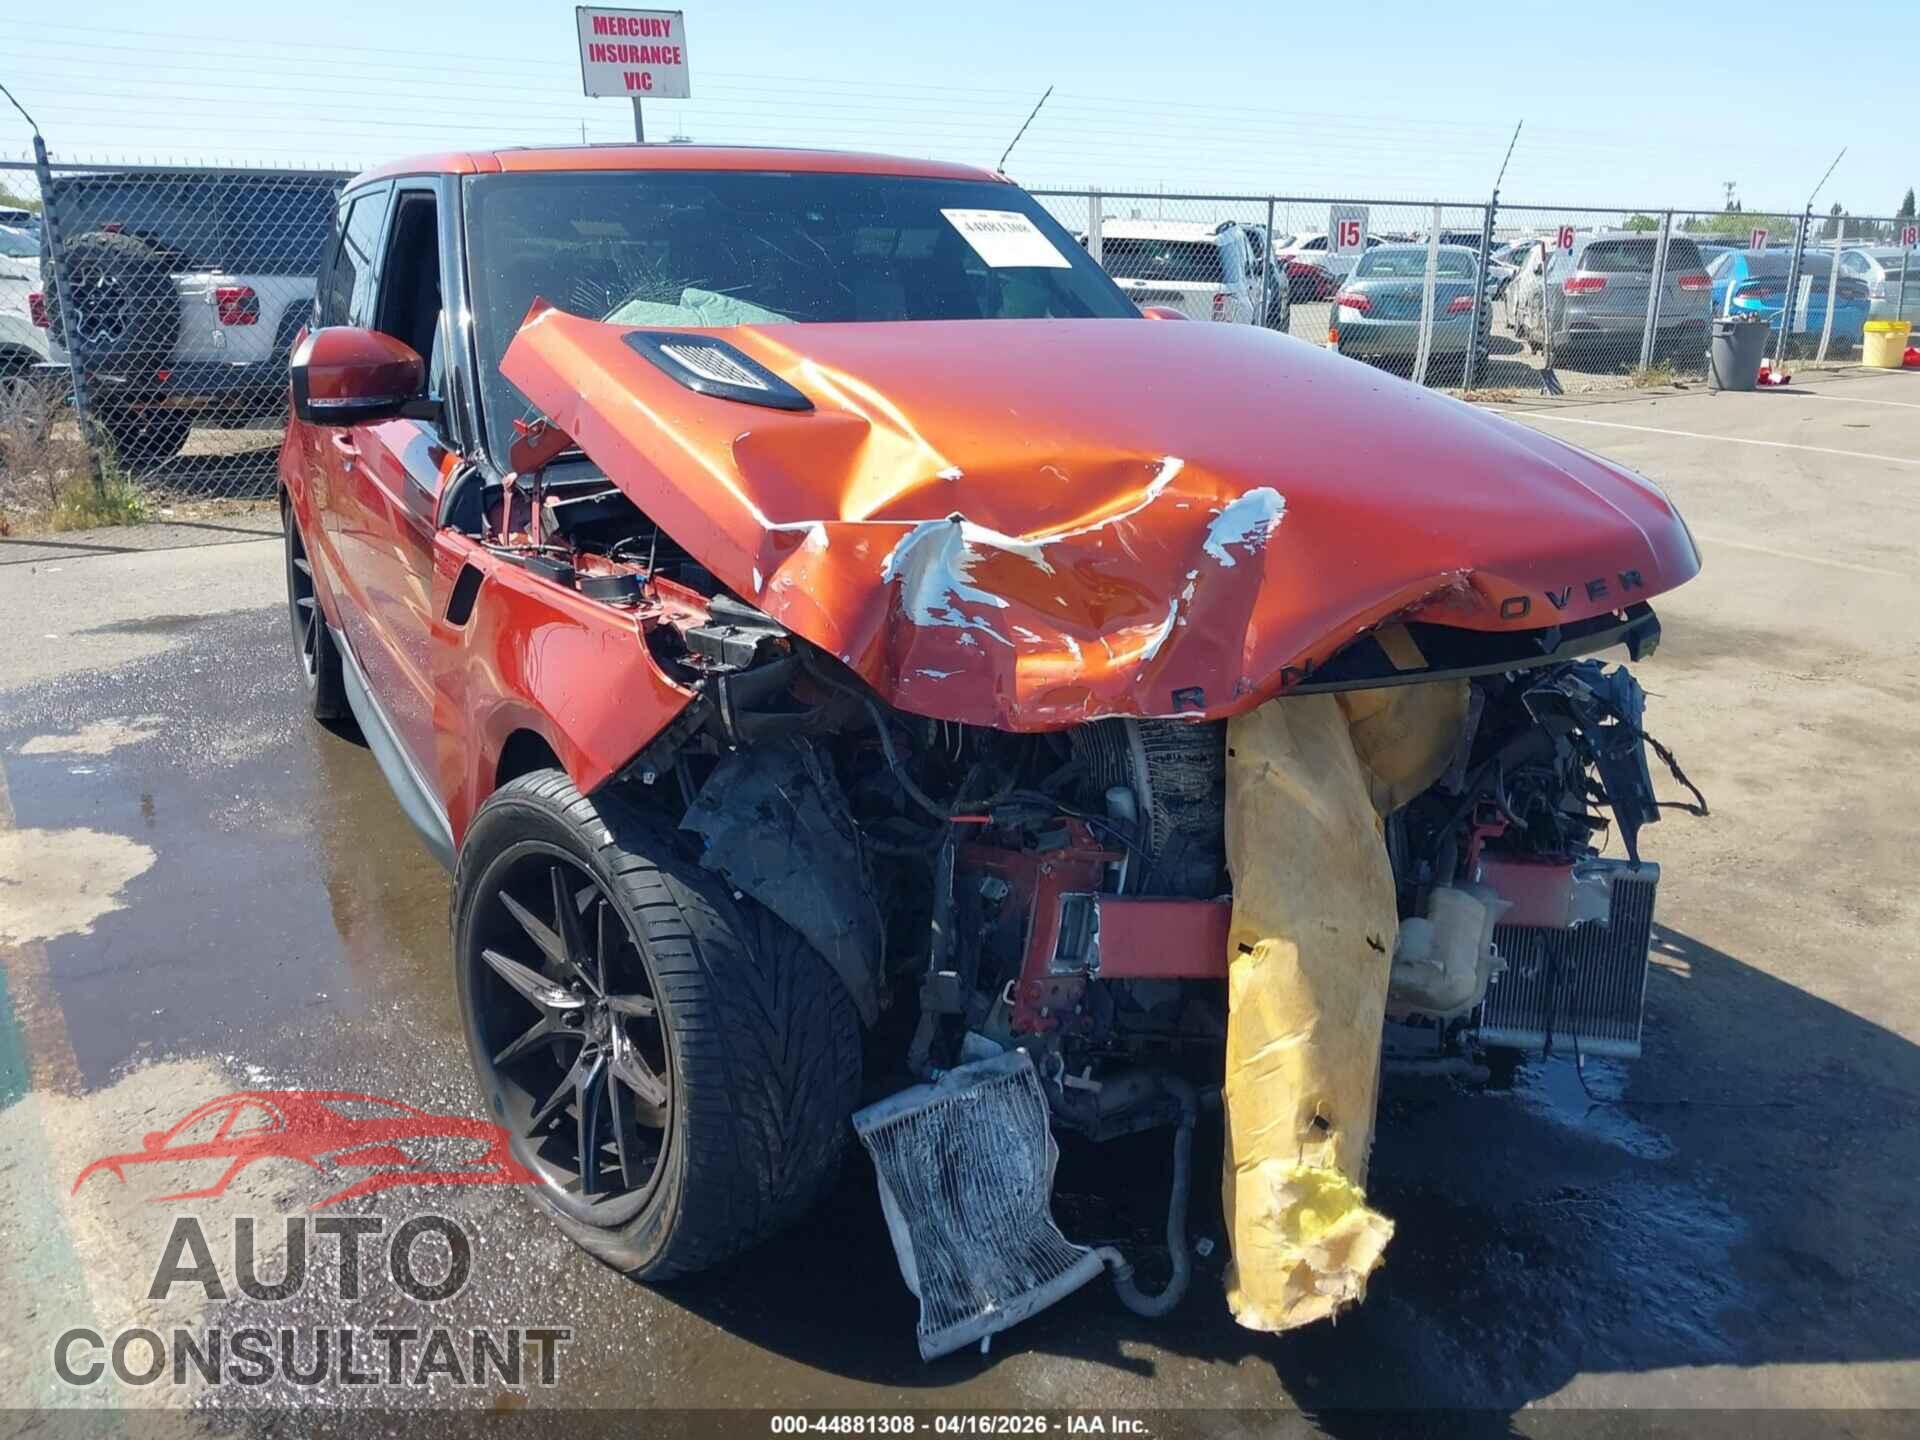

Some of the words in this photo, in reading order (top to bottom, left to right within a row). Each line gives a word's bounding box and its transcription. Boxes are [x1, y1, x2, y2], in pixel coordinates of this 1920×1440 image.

[592, 16, 671, 37] MERCURY
[588, 43, 682, 65] INSURANCE
[623, 71, 653, 90] VIC
[1340, 221, 1360, 247] 15
[1557, 225, 1574, 248] 16
[1751, 229, 1767, 249] 17
[1903, 227, 1917, 246] 18
